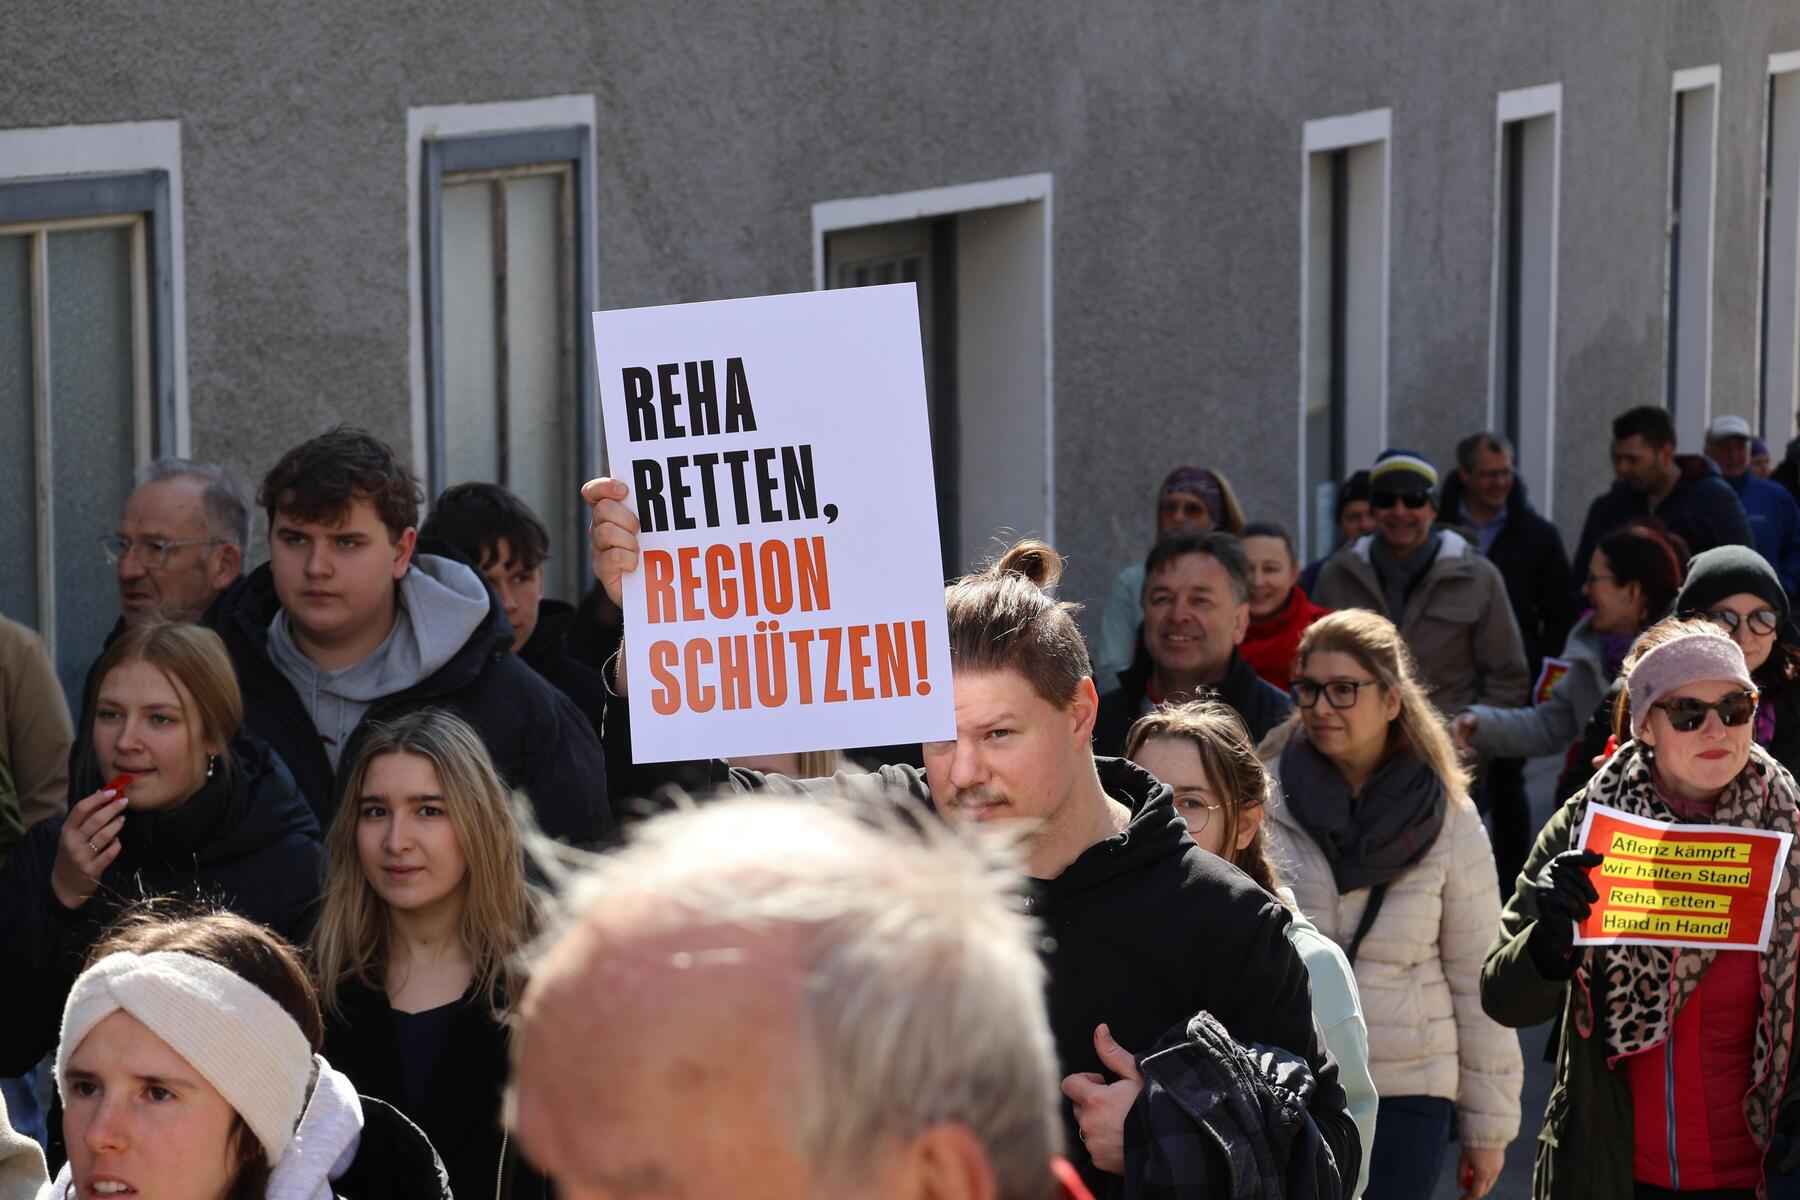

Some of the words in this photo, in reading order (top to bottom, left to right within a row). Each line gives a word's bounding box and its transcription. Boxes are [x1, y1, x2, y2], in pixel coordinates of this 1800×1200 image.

[622, 357, 757, 442] REHA
[632, 444, 839, 533] RETTEN,
[643, 536, 831, 624] REGION
[649, 620, 932, 716] SCHÜTZEN!
[1603, 863, 1633, 875] wir
[1636, 867, 1693, 881] halten
[1698, 869, 1750, 885] Stand
[1612, 837, 1669, 856] Aflenz
[1674, 845, 1737, 862] kämpft
[1603, 914, 1650, 930] Hand
[1655, 917, 1671, 931] in
[1676, 919, 1729, 935] Hand!
[1610, 889, 1656, 905] Reha
[1661, 893, 1715, 909] retten
